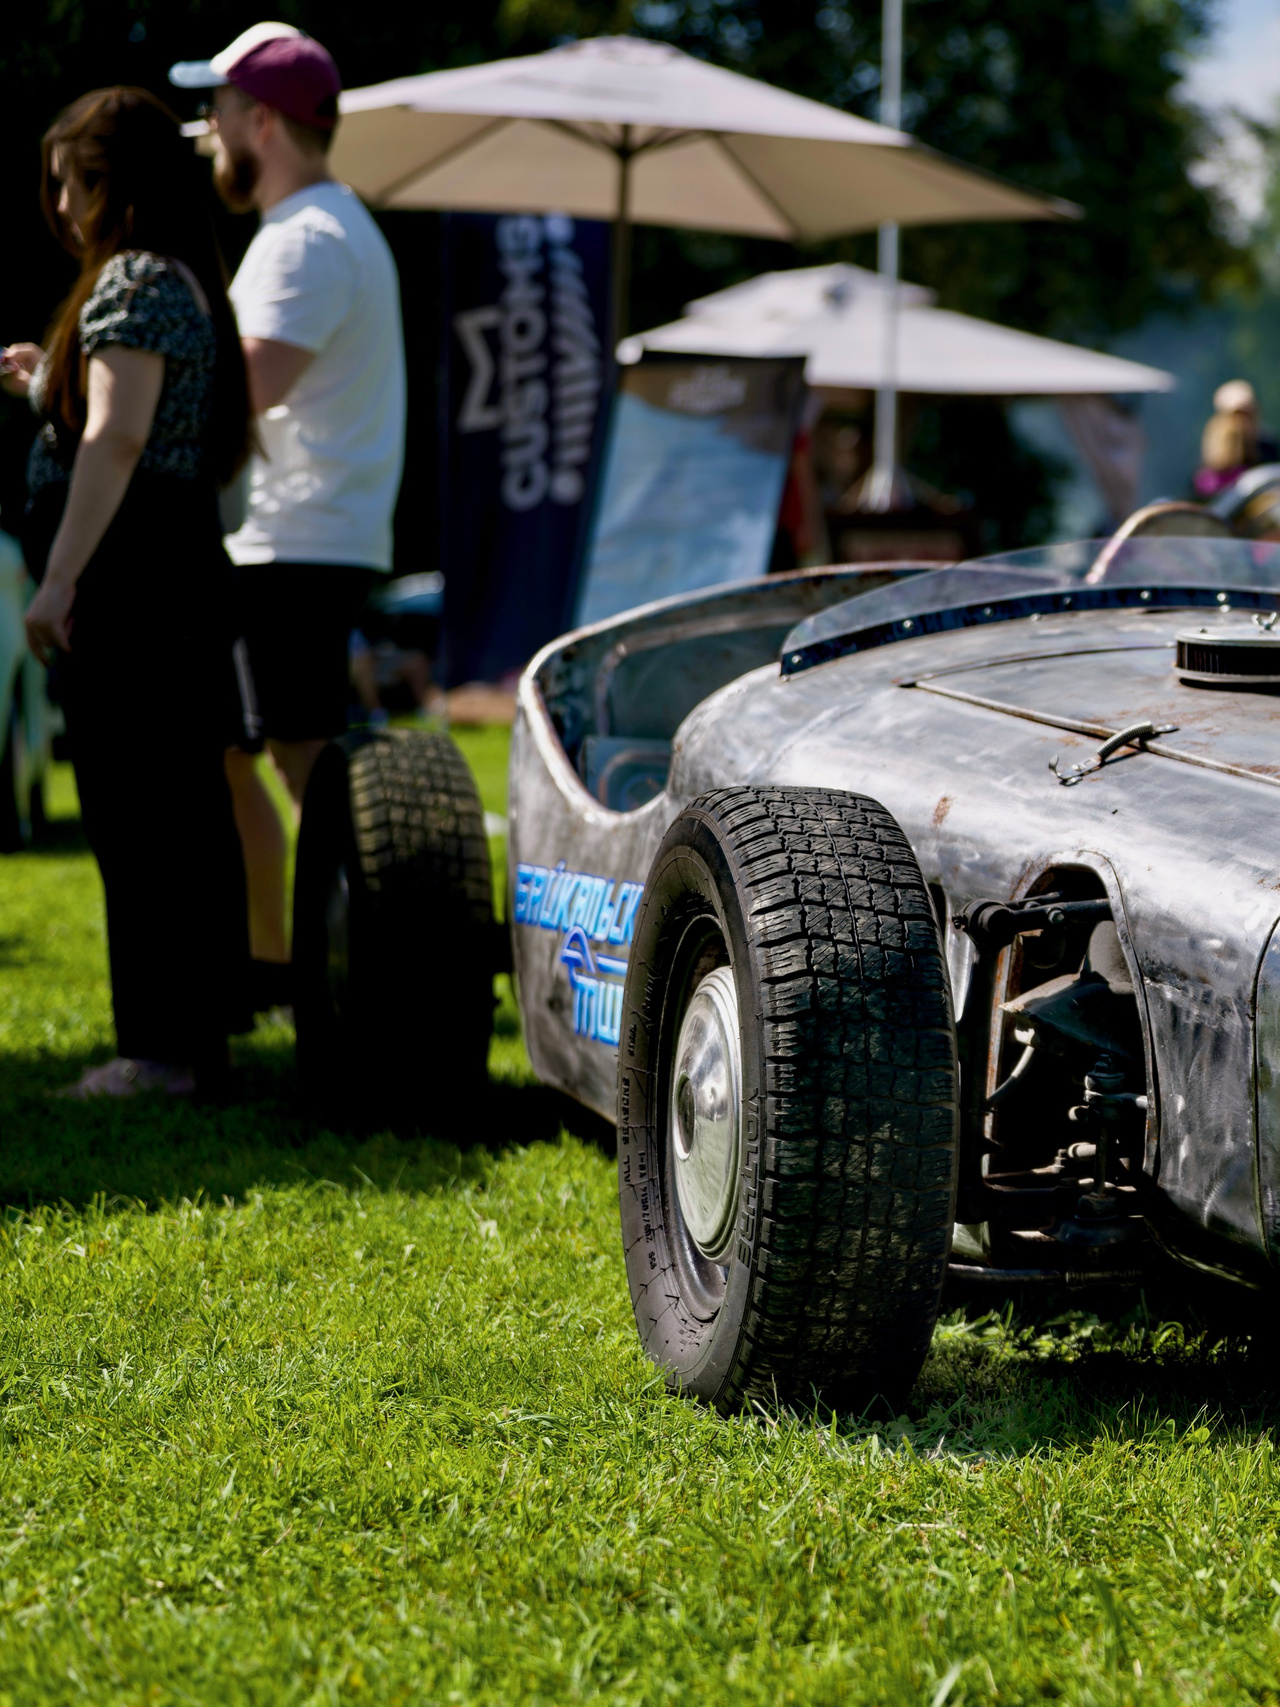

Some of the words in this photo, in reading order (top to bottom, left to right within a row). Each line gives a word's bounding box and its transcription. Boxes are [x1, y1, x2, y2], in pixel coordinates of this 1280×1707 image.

[497, 213, 551, 512] CUSTOMS
[514, 859, 645, 946] БАЙКАЛЬСК
[622, 1154, 631, 1184] ALL
[737, 1086, 760, 1269] VOLTYRE
